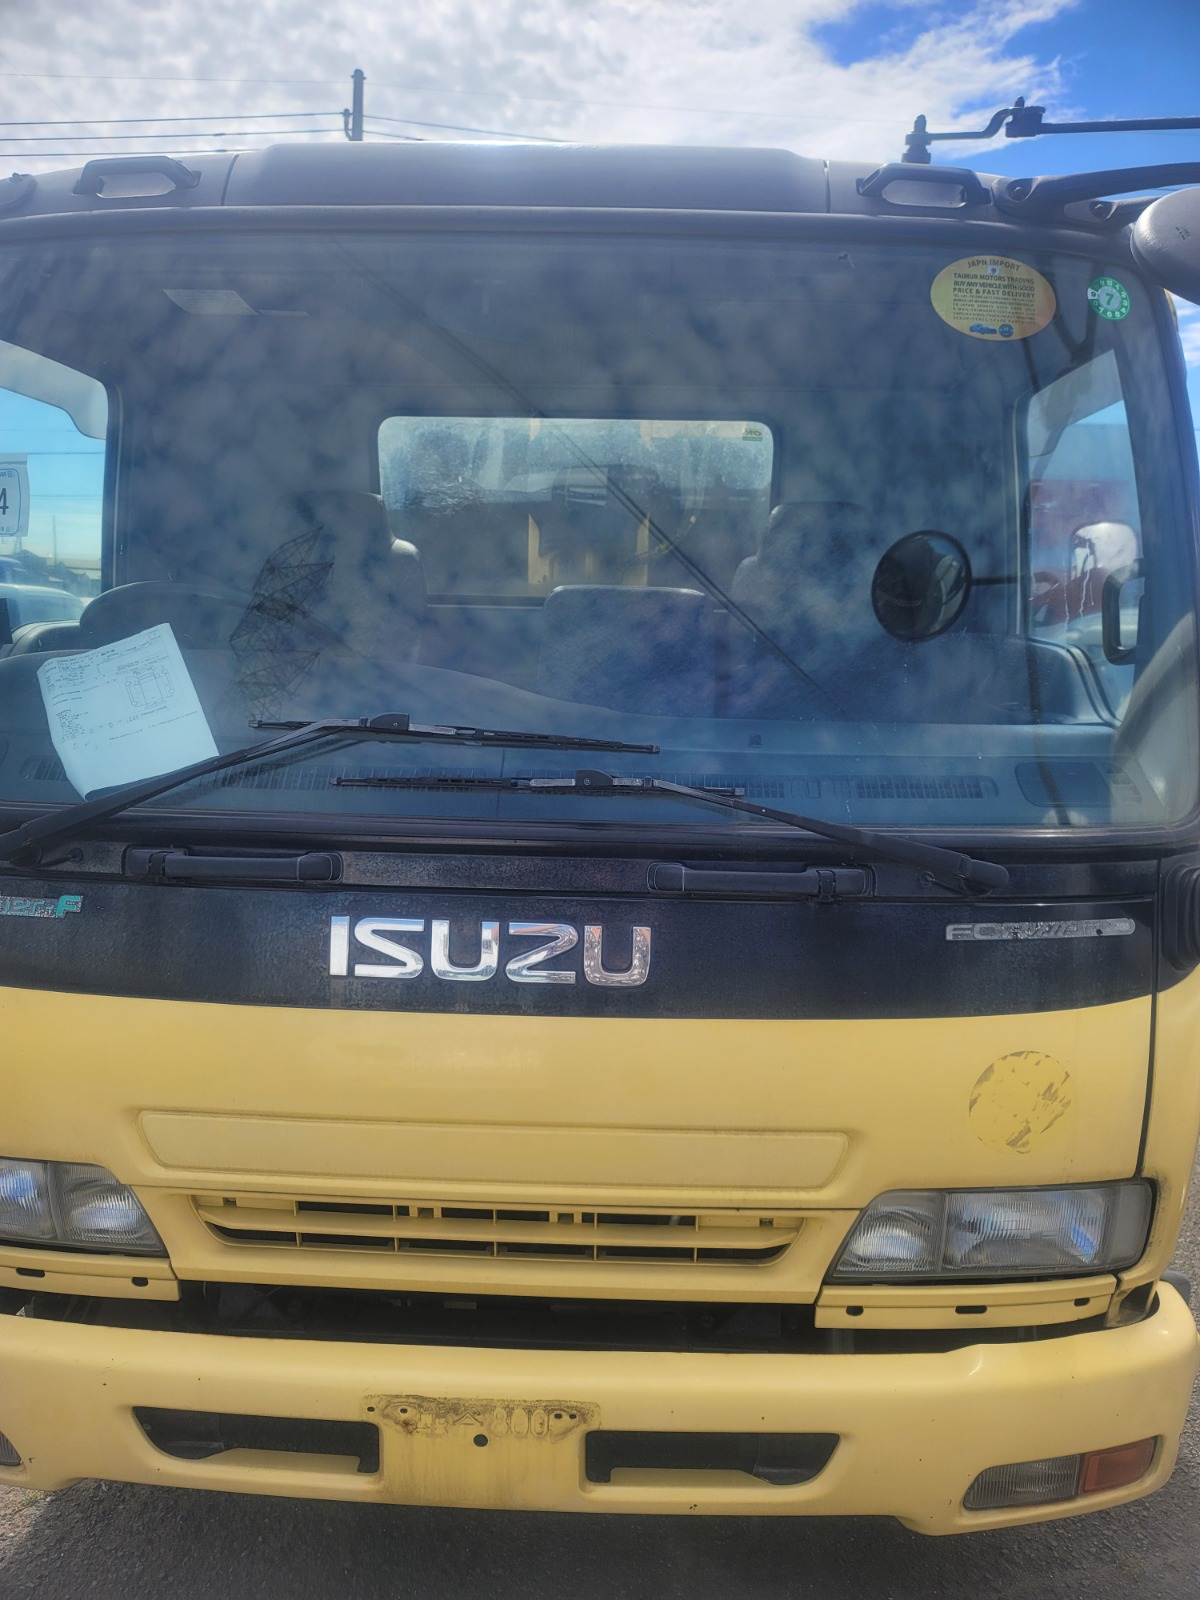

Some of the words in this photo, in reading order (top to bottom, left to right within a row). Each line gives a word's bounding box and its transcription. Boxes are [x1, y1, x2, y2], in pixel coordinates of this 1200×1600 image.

[989, 259, 1020, 271] IMPORT
[1006, 276, 1035, 285] TRADING
[1001, 290, 1036, 299] DELIVERY
[1105, 292, 1115, 306] 7
[329, 915, 651, 986] ISUZU
